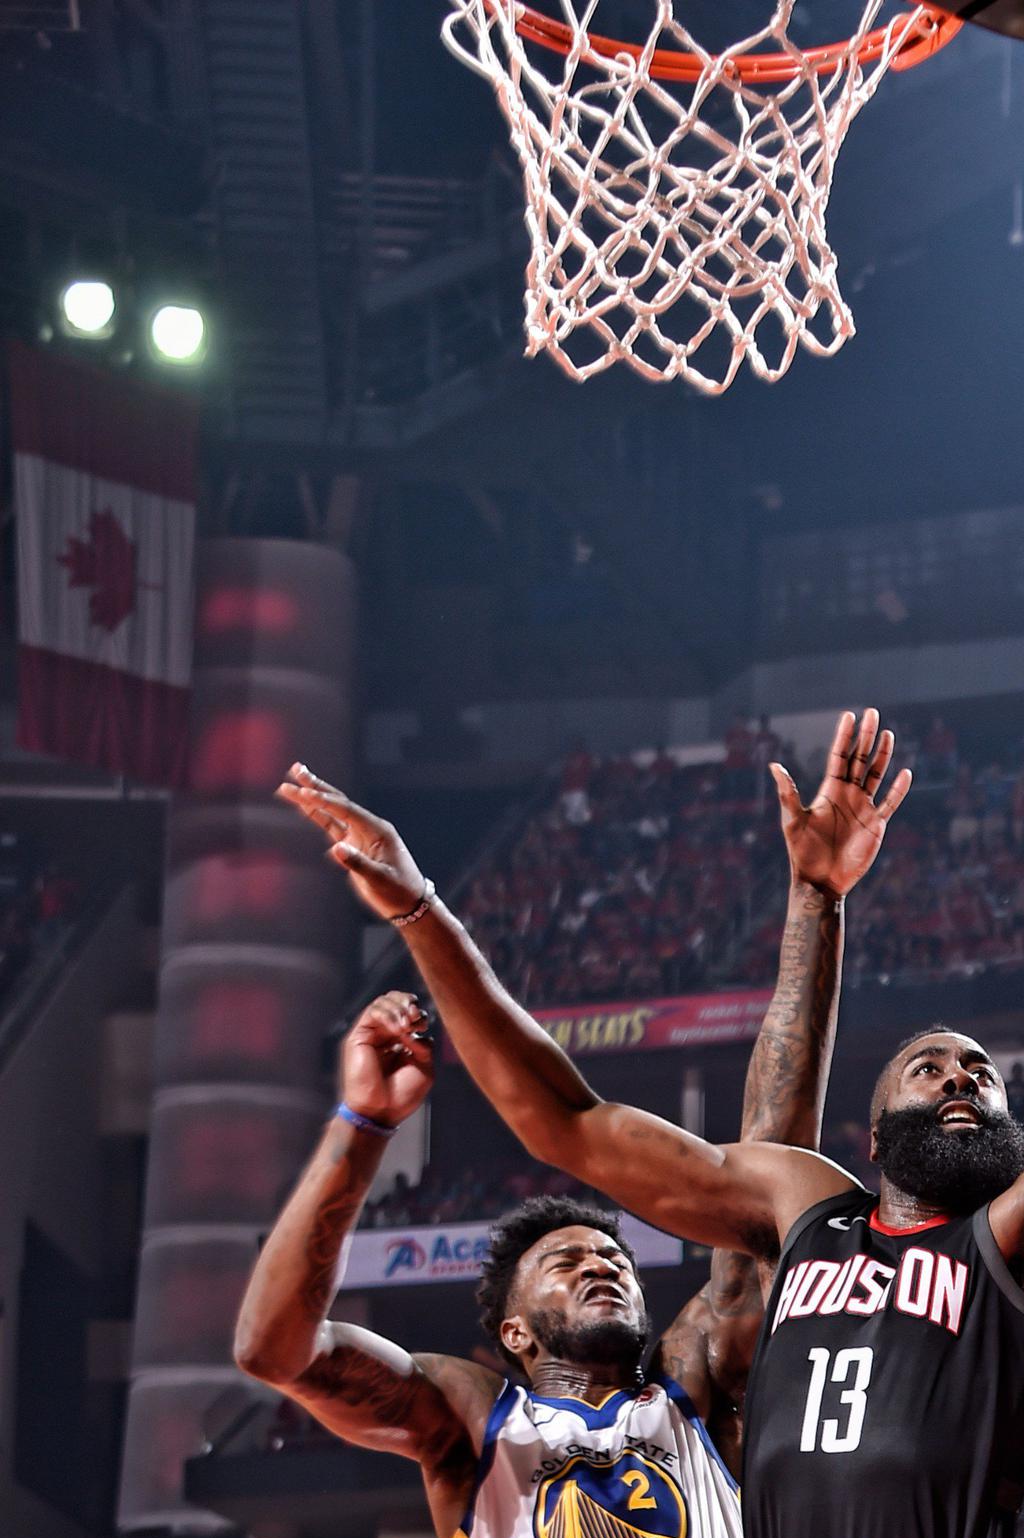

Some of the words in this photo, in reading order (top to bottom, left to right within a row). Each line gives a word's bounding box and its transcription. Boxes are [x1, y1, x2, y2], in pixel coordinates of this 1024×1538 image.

[800, 1346, 874, 1453] 13
[531, 1443, 611, 1484] GOLDEN
[624, 1434, 678, 1468] TATE
[620, 1470, 657, 1511] 2
